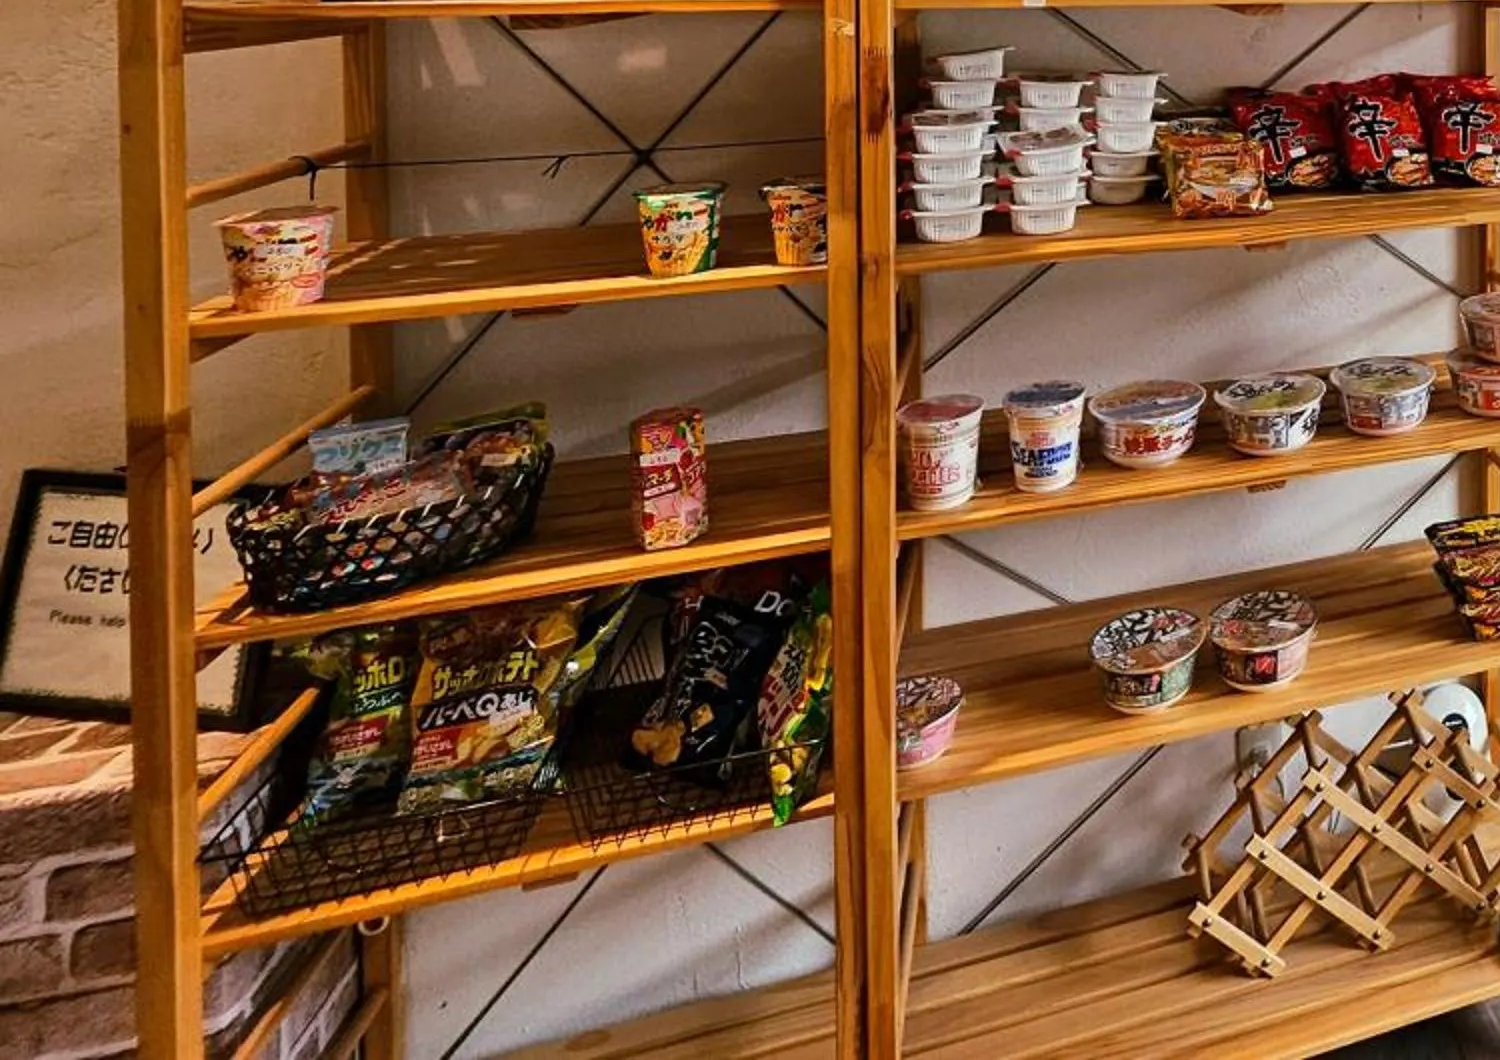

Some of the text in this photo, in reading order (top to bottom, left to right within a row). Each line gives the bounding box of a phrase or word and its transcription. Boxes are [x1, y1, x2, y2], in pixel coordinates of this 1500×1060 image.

[1250, 104, 1302, 164] 辛
[1350, 93, 1398, 162] 辛
[1442, 102, 1496, 154] 辛
[50, 610, 93, 627] Please
